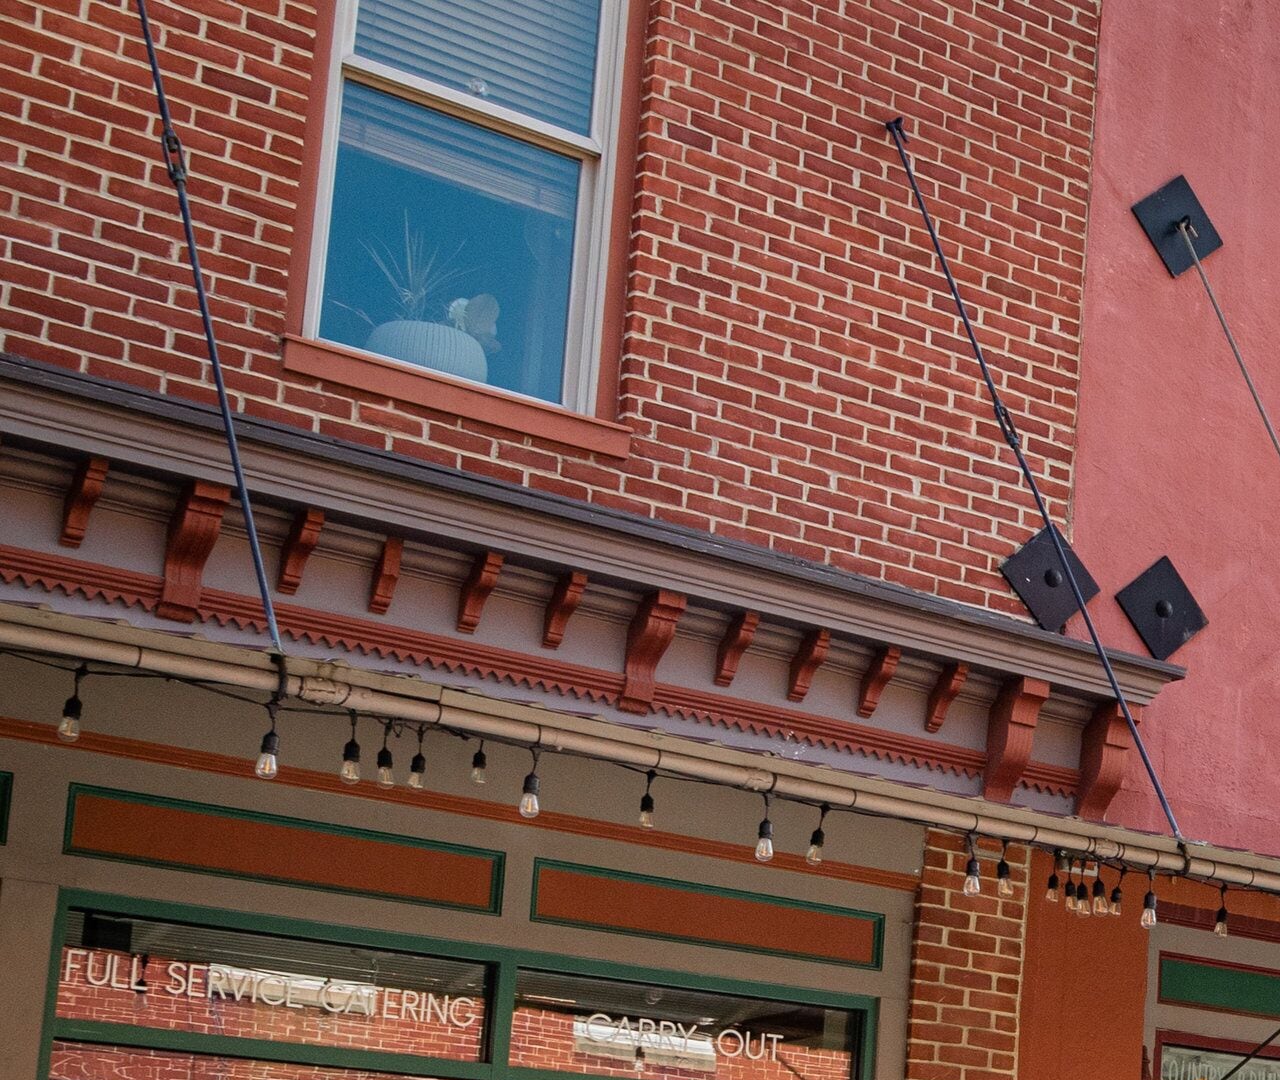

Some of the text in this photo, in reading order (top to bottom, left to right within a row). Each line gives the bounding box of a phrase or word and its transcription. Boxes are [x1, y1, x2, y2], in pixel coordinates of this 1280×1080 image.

[64, 948, 477, 1028] FULL SERVICE CATERING
[585, 1013, 784, 1061] CARRY OUT
